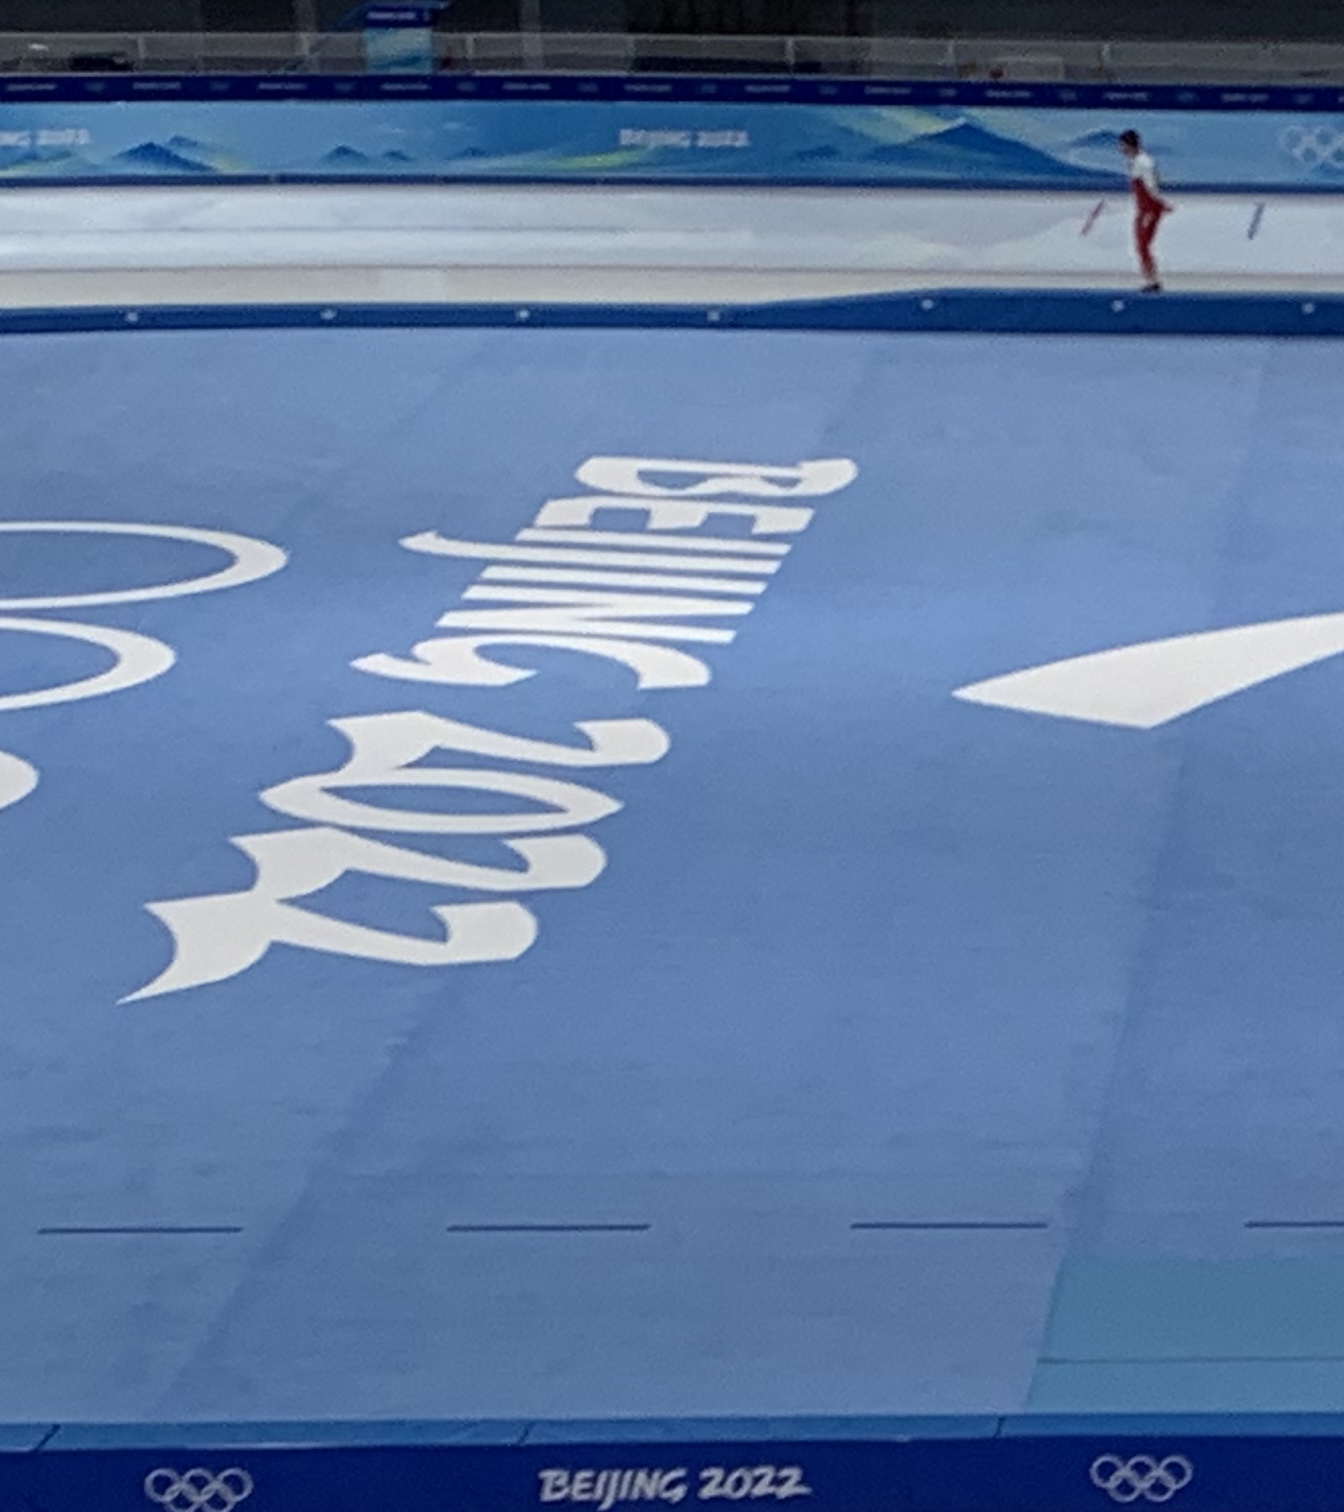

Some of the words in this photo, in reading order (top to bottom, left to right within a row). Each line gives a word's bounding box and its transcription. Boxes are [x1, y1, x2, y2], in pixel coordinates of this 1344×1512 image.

[350, 456, 858, 690] BEIJING
[115, 710, 671, 1005] 2022
[538, 1467, 688, 1512] BEIJING
[697, 1466, 813, 1500] 2022
